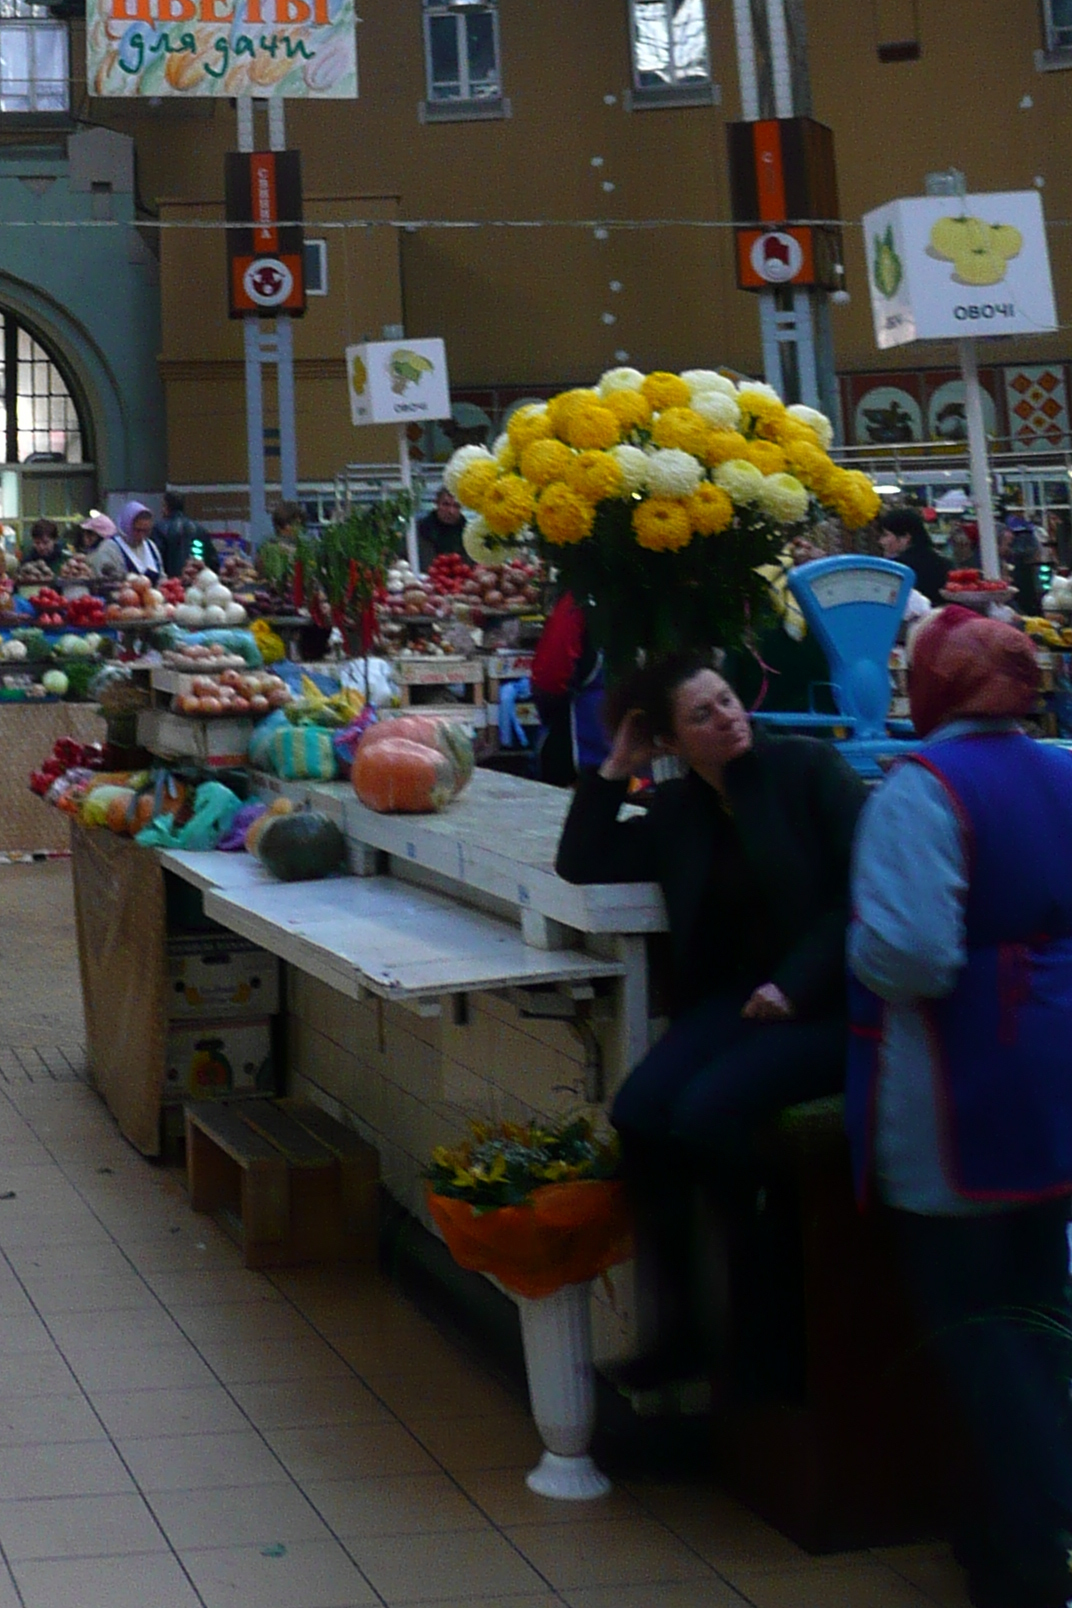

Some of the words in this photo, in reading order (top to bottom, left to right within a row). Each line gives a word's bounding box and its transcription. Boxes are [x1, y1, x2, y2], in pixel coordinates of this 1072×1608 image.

[118, 32, 197, 74] для
[203, 33, 316, 78] дачи
[953, 303, 1015, 320] ОВОЧІ
